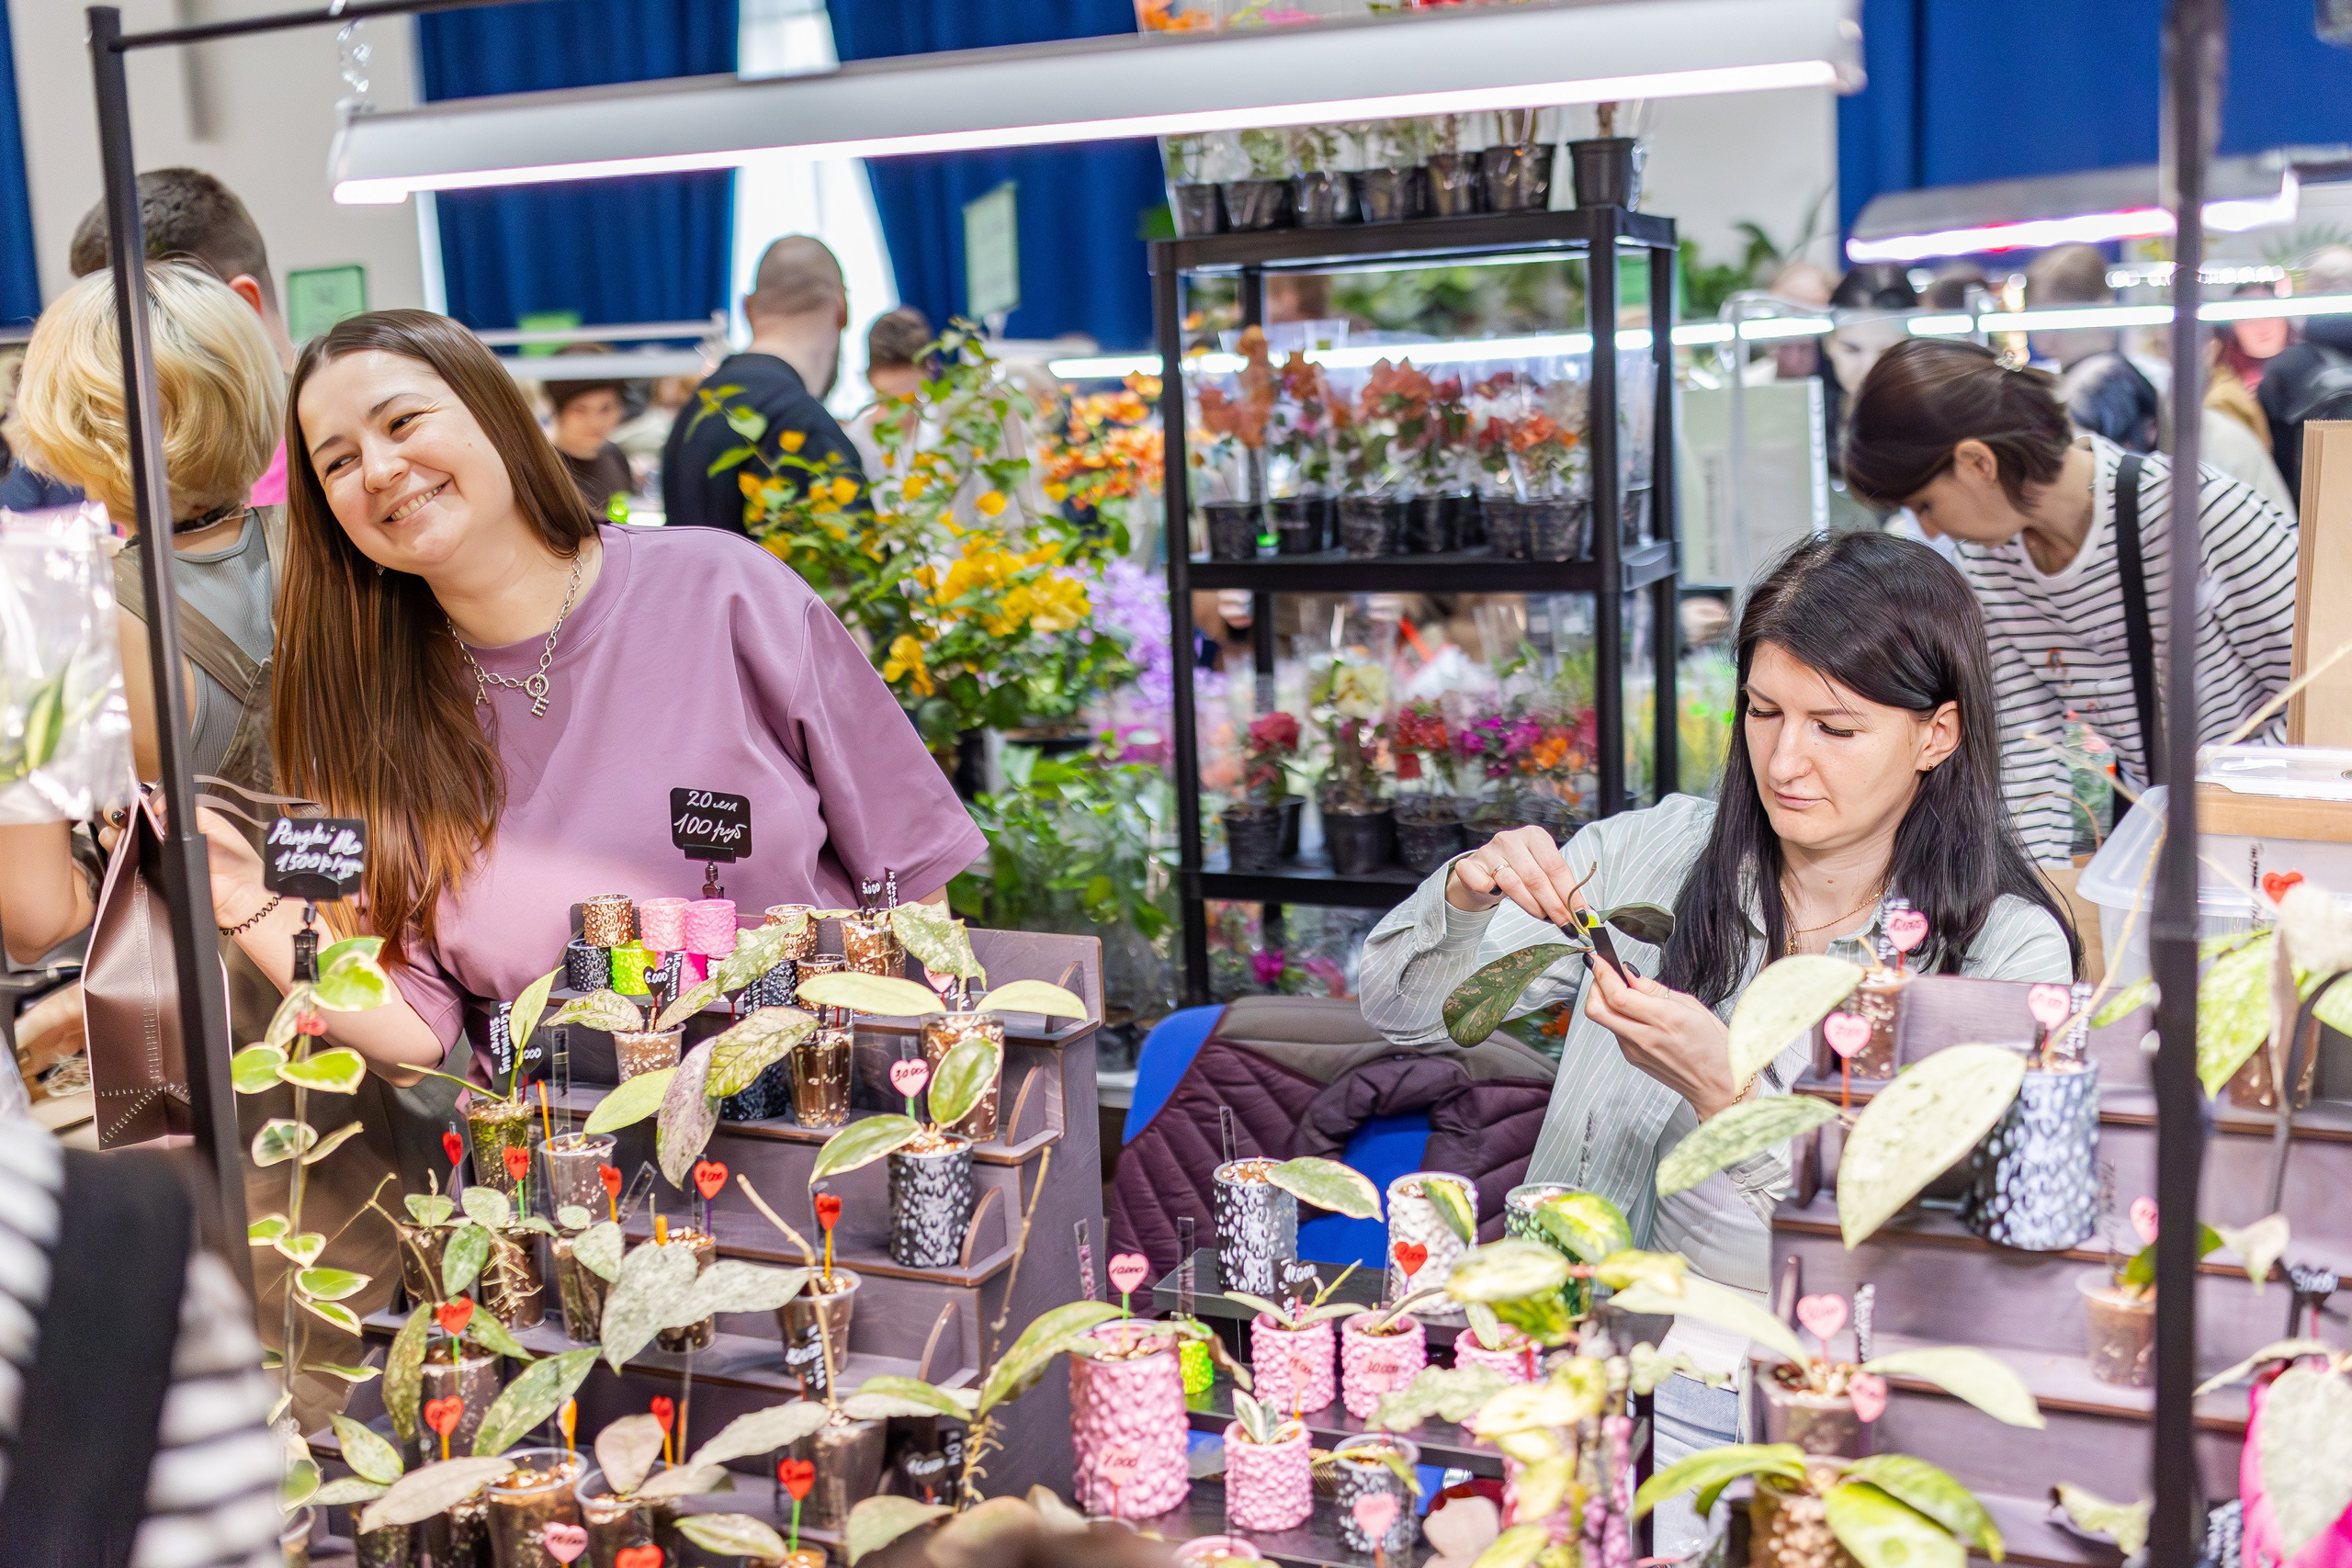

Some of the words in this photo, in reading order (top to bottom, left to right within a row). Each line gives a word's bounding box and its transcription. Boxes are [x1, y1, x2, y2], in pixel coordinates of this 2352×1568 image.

[686, 790, 713, 808] 20
[712, 799, 739, 813] мл
[673, 812, 713, 835] 100
[710, 818, 749, 843] руб
[644, 971, 669, 984] 6.000
[489, 1016, 502, 1055] Silver
